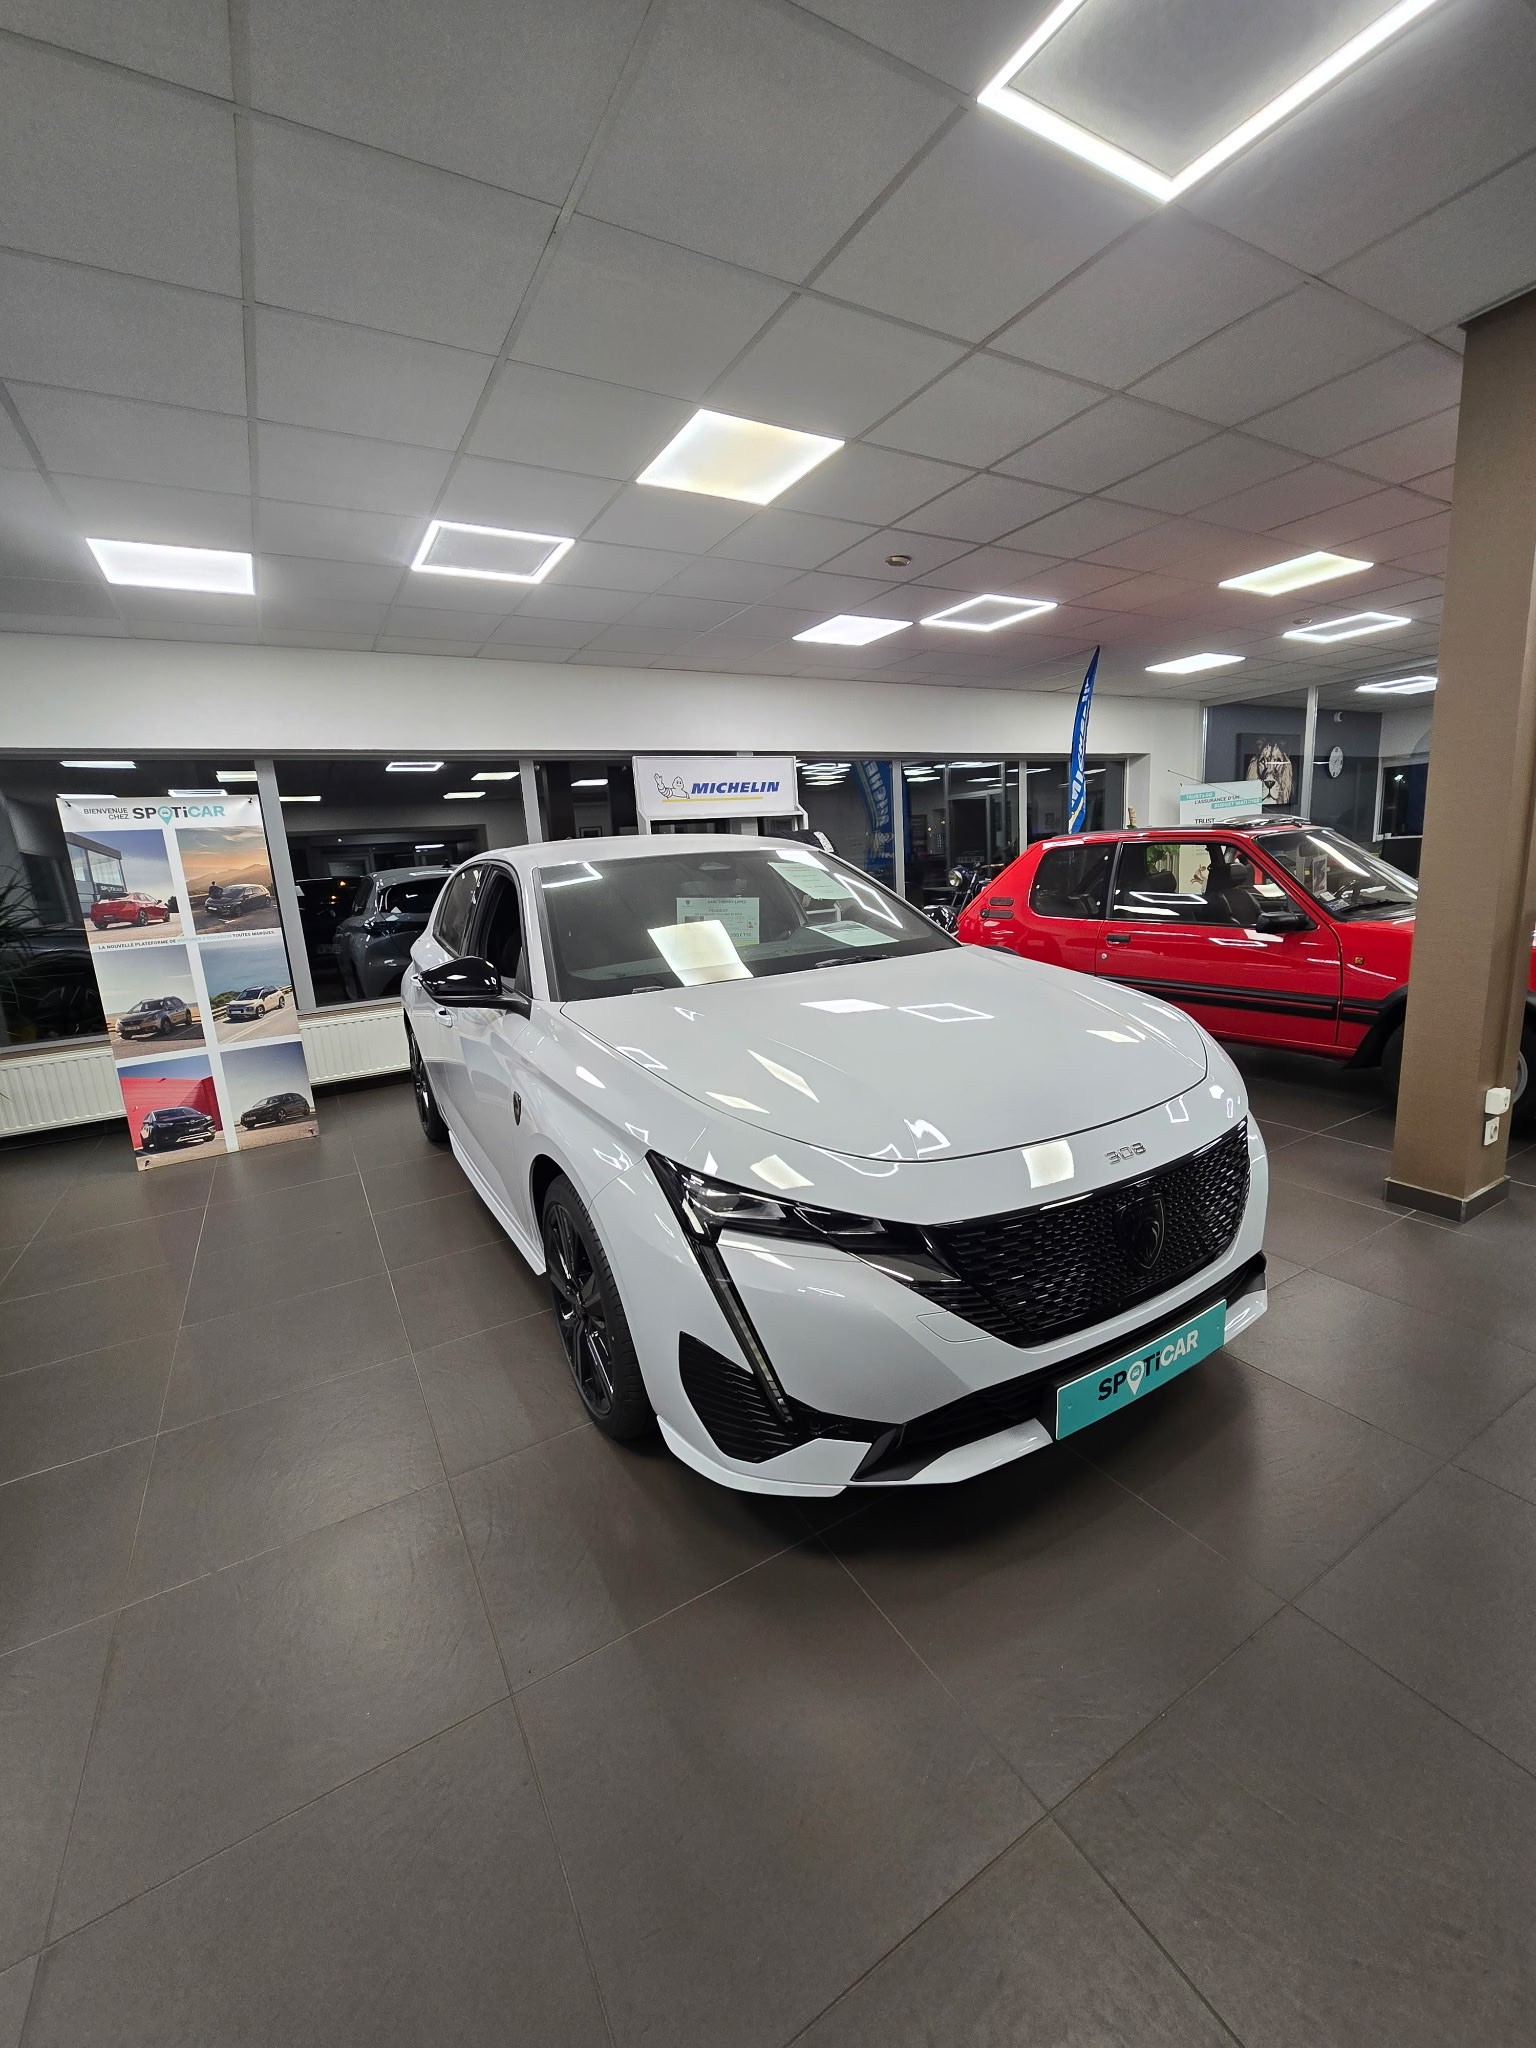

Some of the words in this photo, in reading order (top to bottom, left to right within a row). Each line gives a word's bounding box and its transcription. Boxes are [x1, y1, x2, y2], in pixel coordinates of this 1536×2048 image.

[691, 781, 780, 795] MICHELIN
[1195, 796, 1227, 805] L'ASSURANCE
[83, 807, 128, 815] BIENVENUE
[1104, 1141, 1147, 1165] 308
